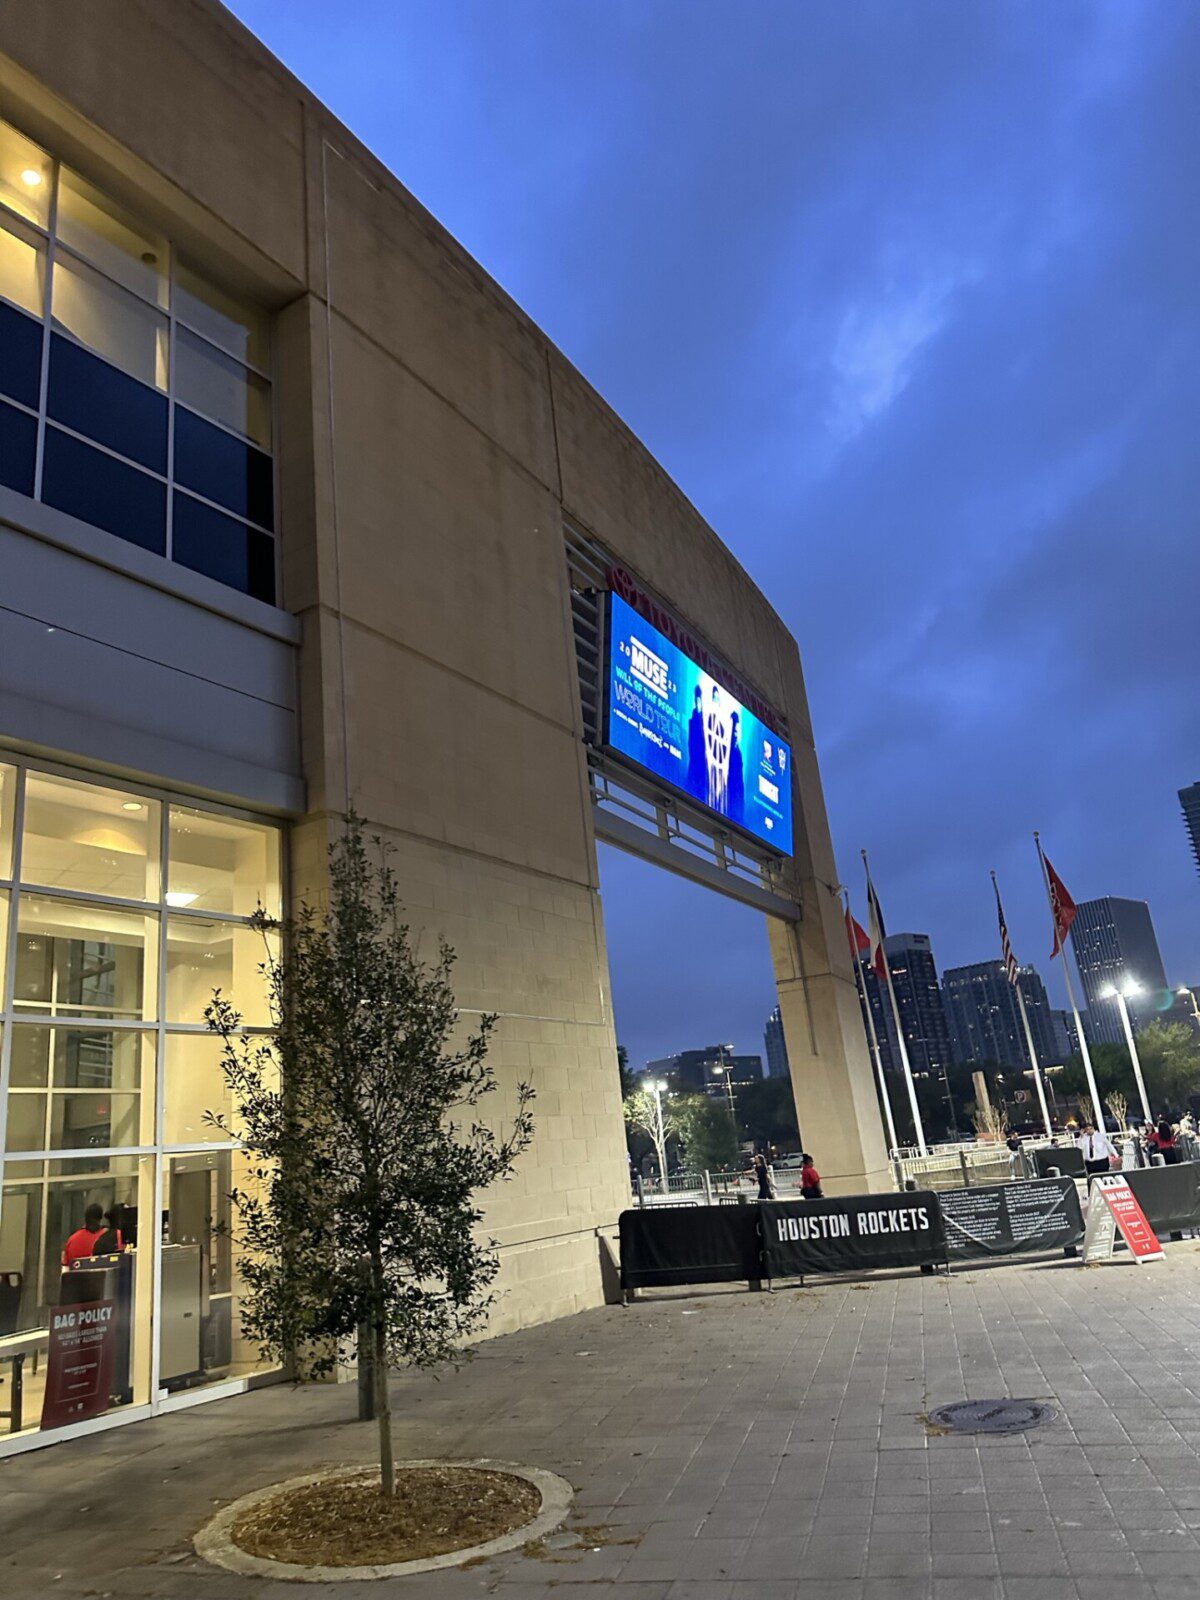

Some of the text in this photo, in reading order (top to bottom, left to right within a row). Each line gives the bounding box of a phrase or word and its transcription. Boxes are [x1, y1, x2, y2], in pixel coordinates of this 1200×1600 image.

[615, 665, 633, 687] WILL
[633, 680, 643, 692] OF
[643, 686, 657, 704] THE
[631, 644, 668, 692] MUSE
[614, 680, 655, 723] WORLD
[654, 709, 681, 743] TOUR
[777, 1214, 850, 1241] HOUSTON
[857, 1207, 929, 1235] ROCKETS
[54, 1307, 112, 1329] BAG POLICY
